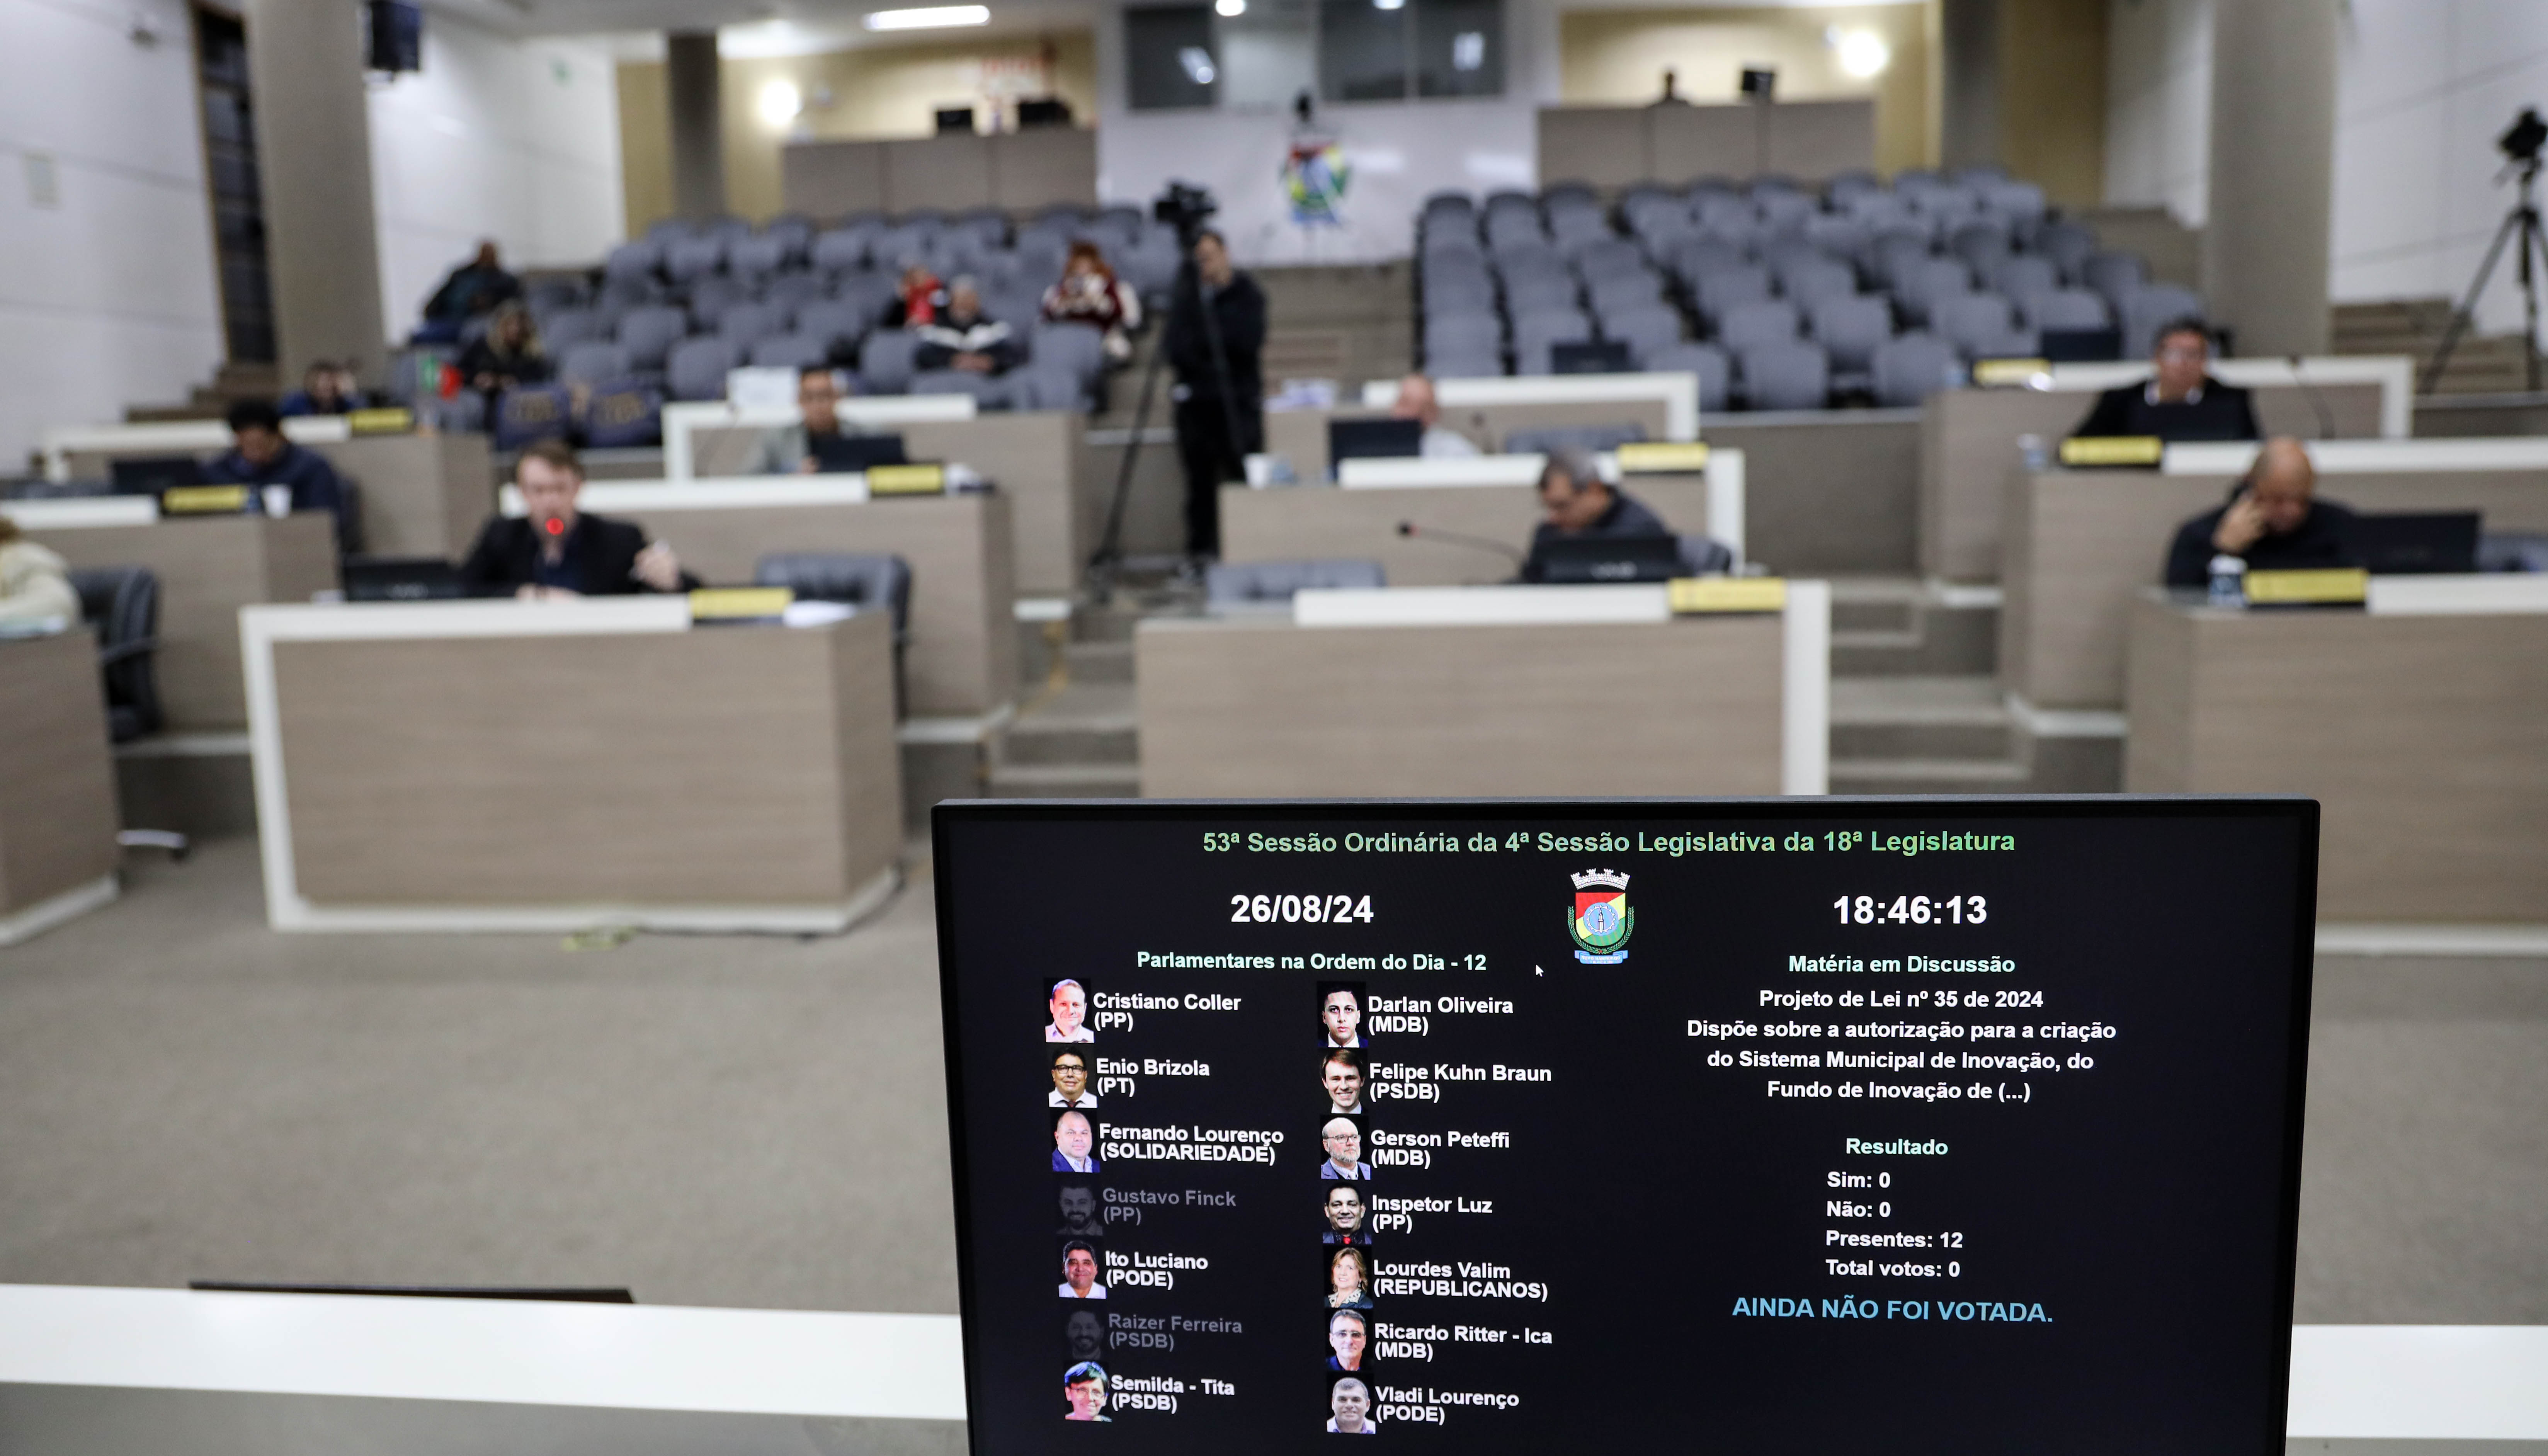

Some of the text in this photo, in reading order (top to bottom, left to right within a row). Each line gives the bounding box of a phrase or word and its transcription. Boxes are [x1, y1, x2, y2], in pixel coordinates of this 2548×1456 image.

[1203, 830, 2015, 857] 53ª Sessão Ordinária da 4ª Sessão Legislativa da 18ª Legislatura
[1231, 895, 1374, 923] 26/08/24
[1834, 895, 1987, 924] 18:46:13
[1137, 951, 1275, 969] Parlamentares
[1281, 957, 1305, 969] na
[1310, 953, 1376, 970] Ordem
[1381, 954, 1407, 970] do
[1413, 954, 1445, 970] Dia
[1464, 954, 1486, 970] 12
[1789, 954, 2016, 972] Matéria em Discussão
[1093, 992, 1242, 1010] Cristiano Coller
[1368, 996, 1514, 1014] Darlan Oliveira
[1760, 990, 2044, 1010] Projeto de Lei nº 35 de 2024
[1094, 1012, 1133, 1032] (PP)
[1368, 1015, 1429, 1036] (MDB)
[1687, 1020, 2116, 1042] Dispõe sobre a autorização para a criação
[1096, 1058, 1210, 1076] Enio Brizola
[1707, 1050, 2094, 1073] do Sistema Municipal de Inovação, do
[1370, 1063, 1551, 1083] Felipe Kuhn Braun
[1097, 1077, 1135, 1097] (PT)
[1370, 1082, 1440, 1103] (PSDB)
[1768, 1080, 2031, 1103] Fundo de Inovação de (...)
[1099, 1123, 1284, 1147] Fernando Lourenço
[1371, 1129, 1509, 1148] Gerson Peteffi
[1100, 1142, 1276, 1166] (SOLIDARIEDADE)
[1846, 1138, 1948, 1155] Resultado
[1371, 1148, 1430, 1170] (MDB)
[1827, 1171, 1891, 1188] Sim: 0
[1102, 1187, 1237, 1207] Gustavo Finck
[1372, 1194, 1493, 1215] Inspetor Luz
[1103, 1205, 1141, 1226] (PP)
[1827, 1201, 1891, 1218] Não: 0
[1372, 1213, 1412, 1234] (PP)
[1826, 1230, 1963, 1248] Presentes: 12
[1105, 1250, 1208, 1270] Ito Luciano
[1374, 1259, 1510, 1279] Lourdes Valim
[1825, 1259, 1960, 1277] Total votos: 0
[1106, 1269, 1174, 1291] (PODE)
[1374, 1278, 1548, 1303] (REPUBLICANOS)
[1732, 1294, 2053, 1322] AINDA NÃO FOI VOTADA.
[1108, 1313, 1242, 1334] Raizer Ferreira
[1375, 1323, 1449, 1341] Ricardo
[1454, 1325, 1507, 1342] Ritter
[1525, 1327, 1552, 1344] Ica
[1109, 1331, 1174, 1352] (PSDB)
[1375, 1341, 1433, 1362] (MDB)
[1111, 1374, 1184, 1393] Semilda
[1201, 1378, 1235, 1395] Tita
[1112, 1392, 1177, 1414] (PSDB)
[1375, 1386, 1519, 1410] Vladi Lourenço
[1376, 1404, 1445, 1426] (PODE)
